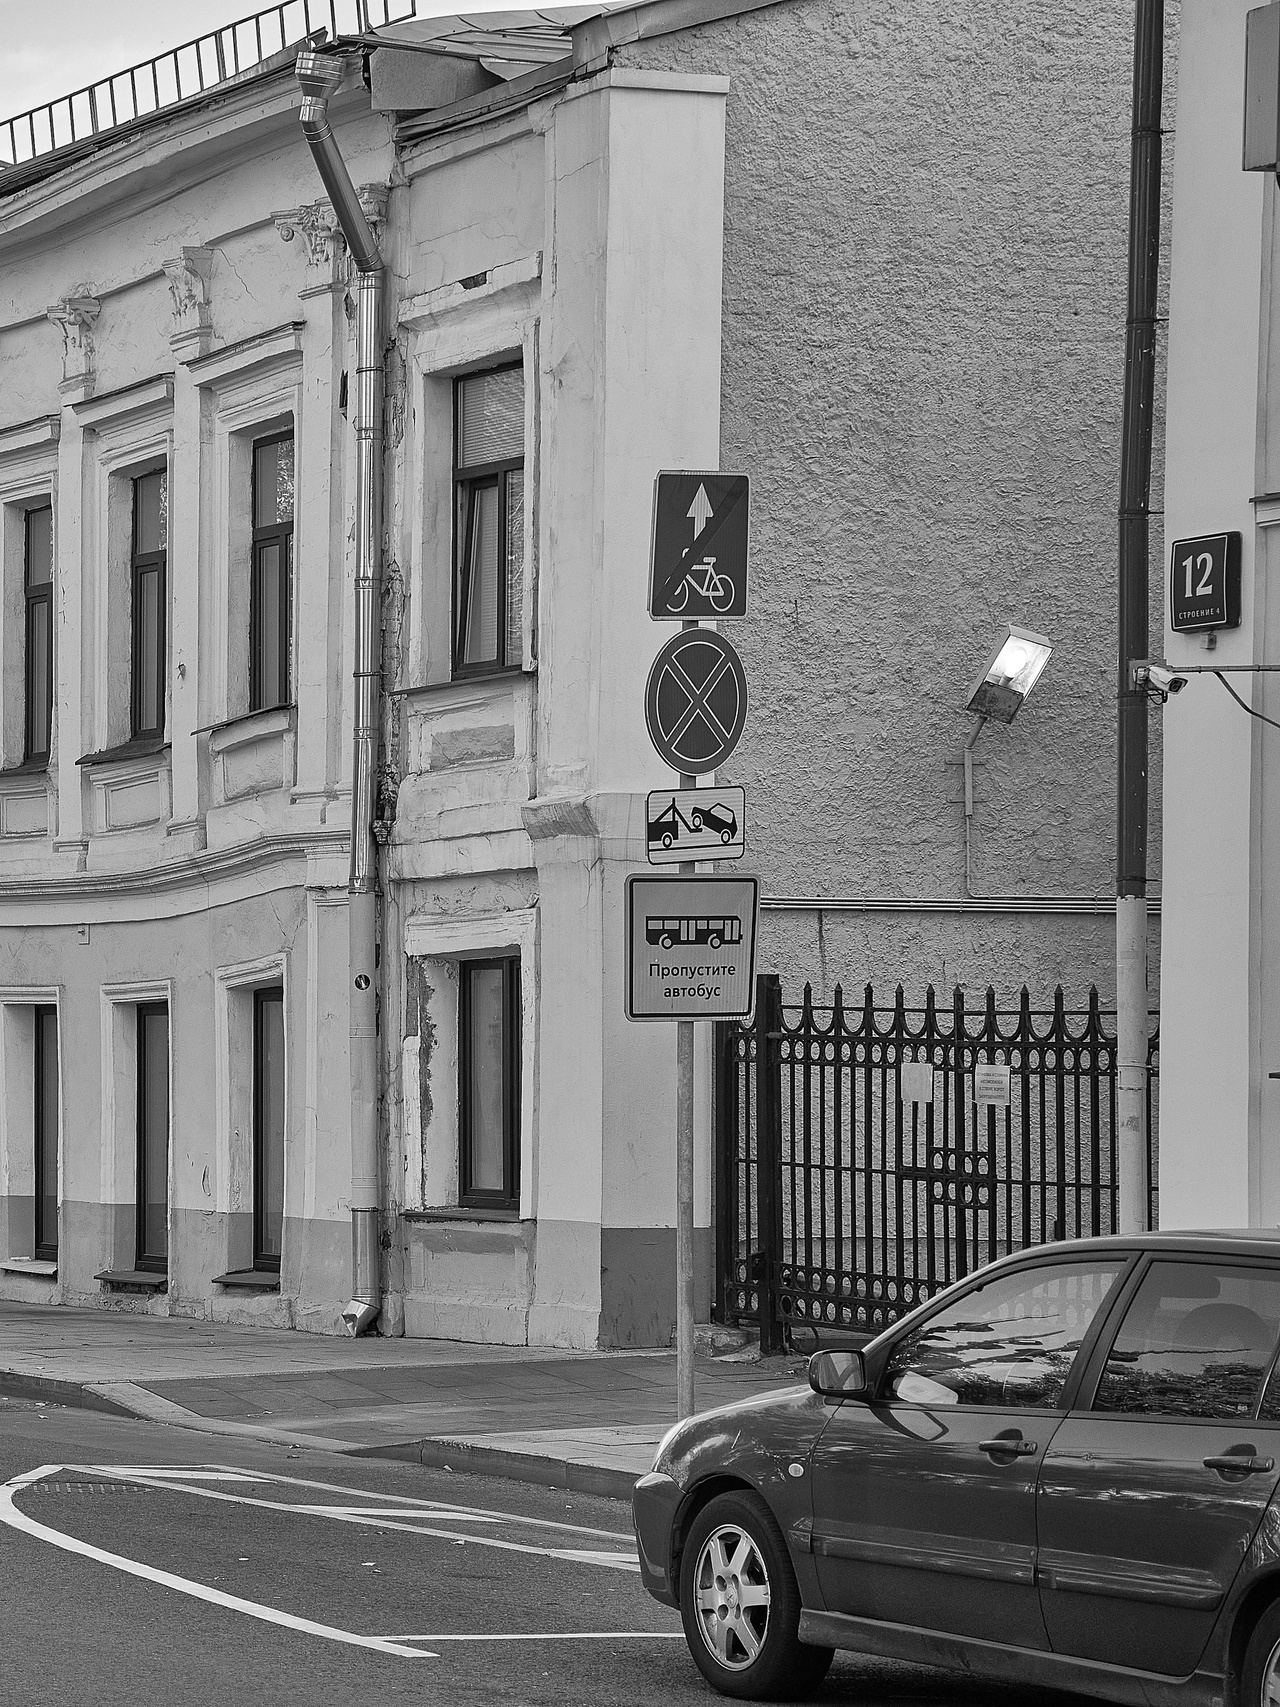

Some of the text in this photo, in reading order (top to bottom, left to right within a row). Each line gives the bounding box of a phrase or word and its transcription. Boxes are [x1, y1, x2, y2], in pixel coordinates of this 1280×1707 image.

[1182, 552, 1213, 598] 12
[1178, 608, 1215, 620] СТРОЕНИЕ
[649, 963, 736, 979] Пропустите
[663, 983, 721, 999] автобус
